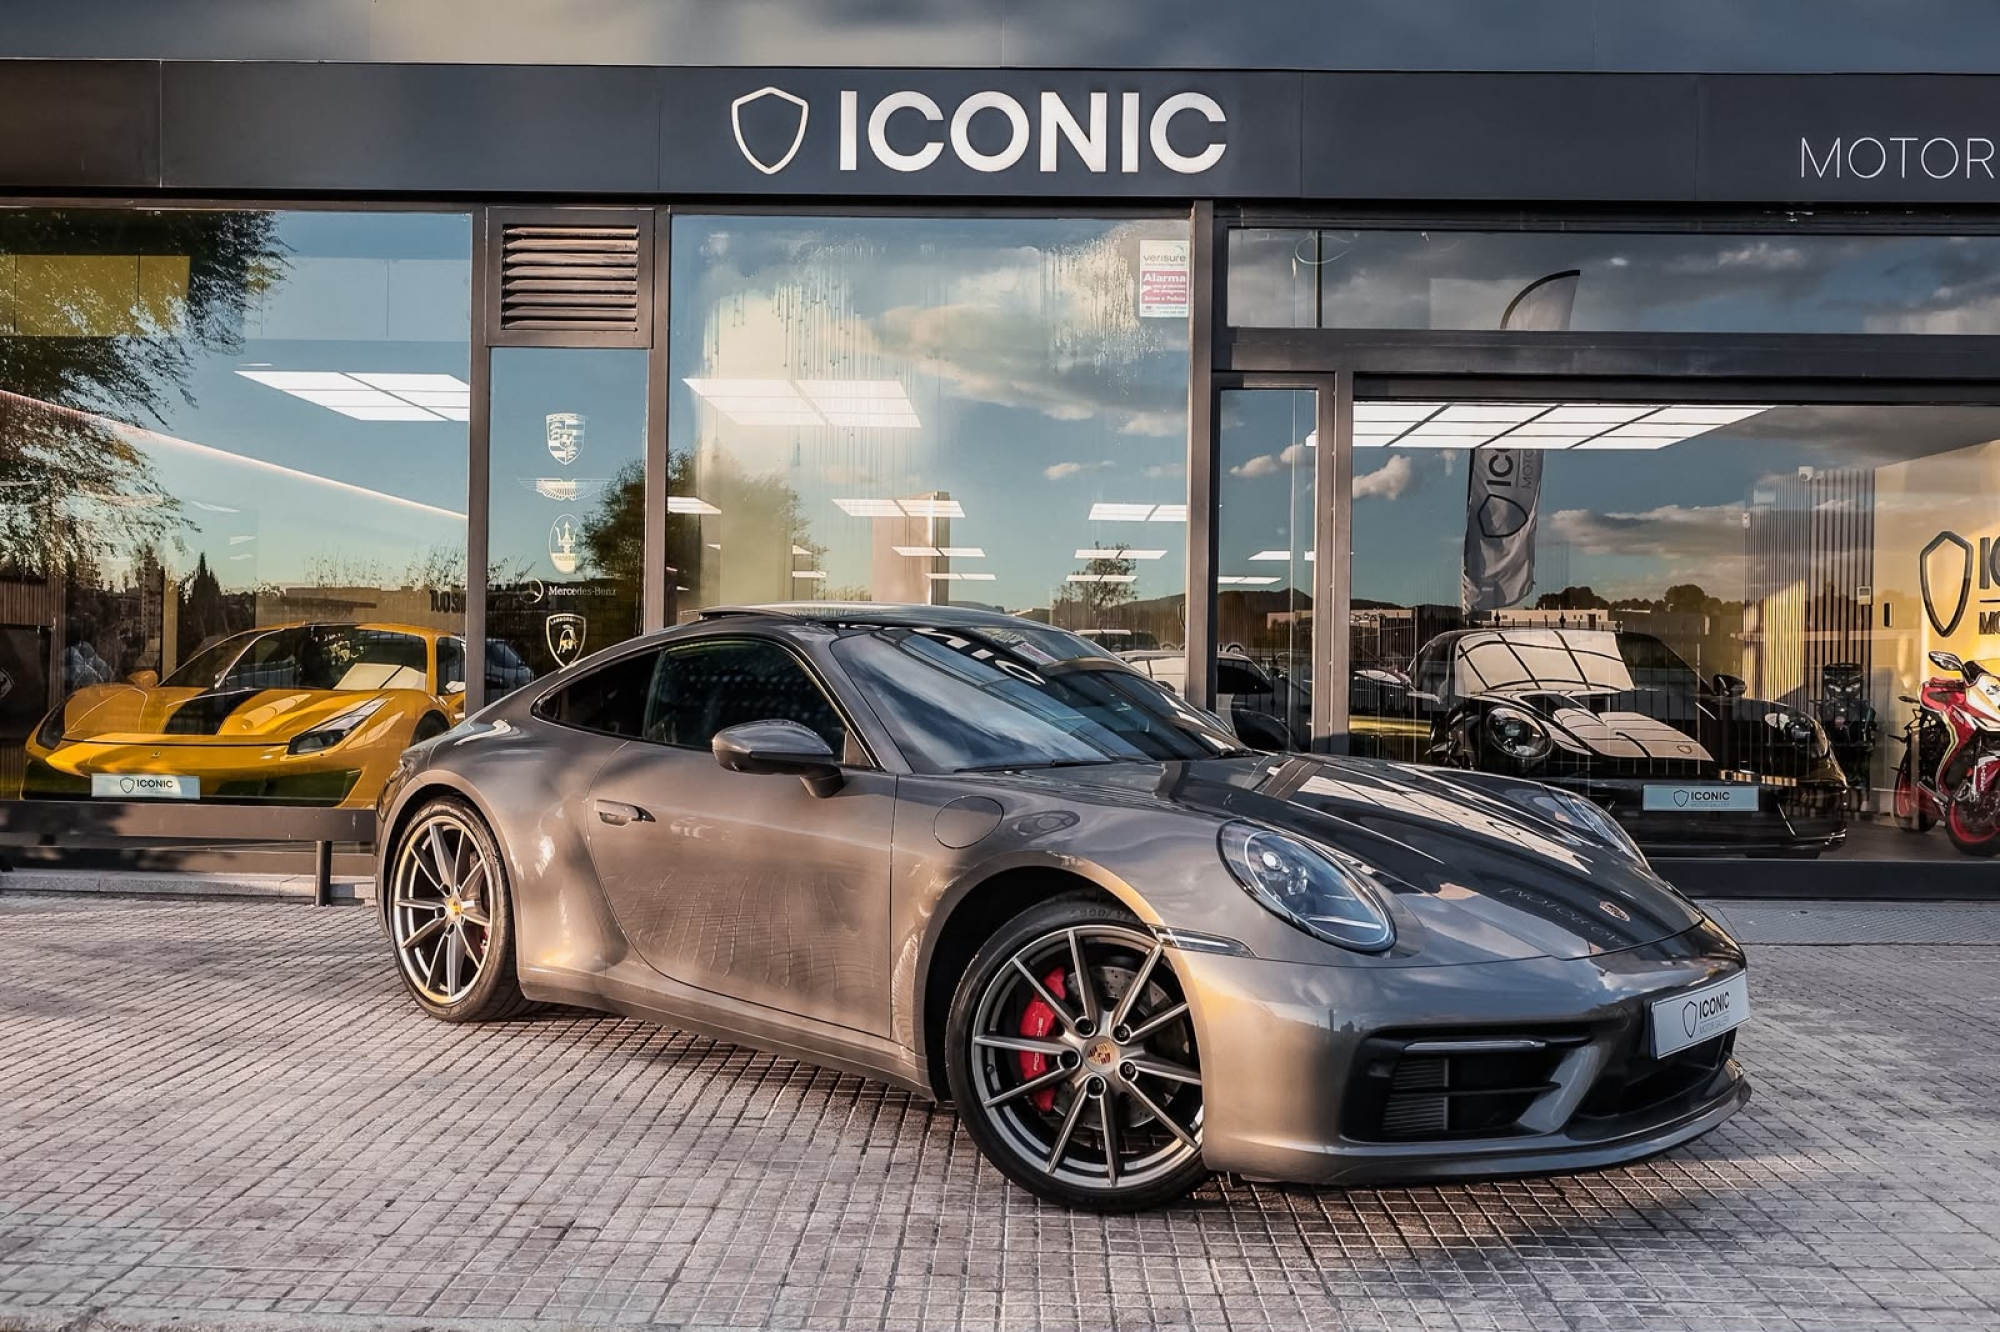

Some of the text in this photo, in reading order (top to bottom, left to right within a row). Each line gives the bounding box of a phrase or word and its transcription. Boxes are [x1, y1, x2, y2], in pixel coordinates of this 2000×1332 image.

[839, 90, 1228, 174] ICONIC
[1800, 137, 1995, 179] MOTOR
[1143, 254, 1187, 262] verisure
[1143, 272, 1187, 282] Alarma
[1486, 449, 1514, 487] IC
[549, 585, 617, 597] Mercedes-Benz
[136, 779, 174, 789] ICONIC
[1690, 791, 1731, 801] ICONIC
[1699, 991, 1730, 1019] ICONIC
